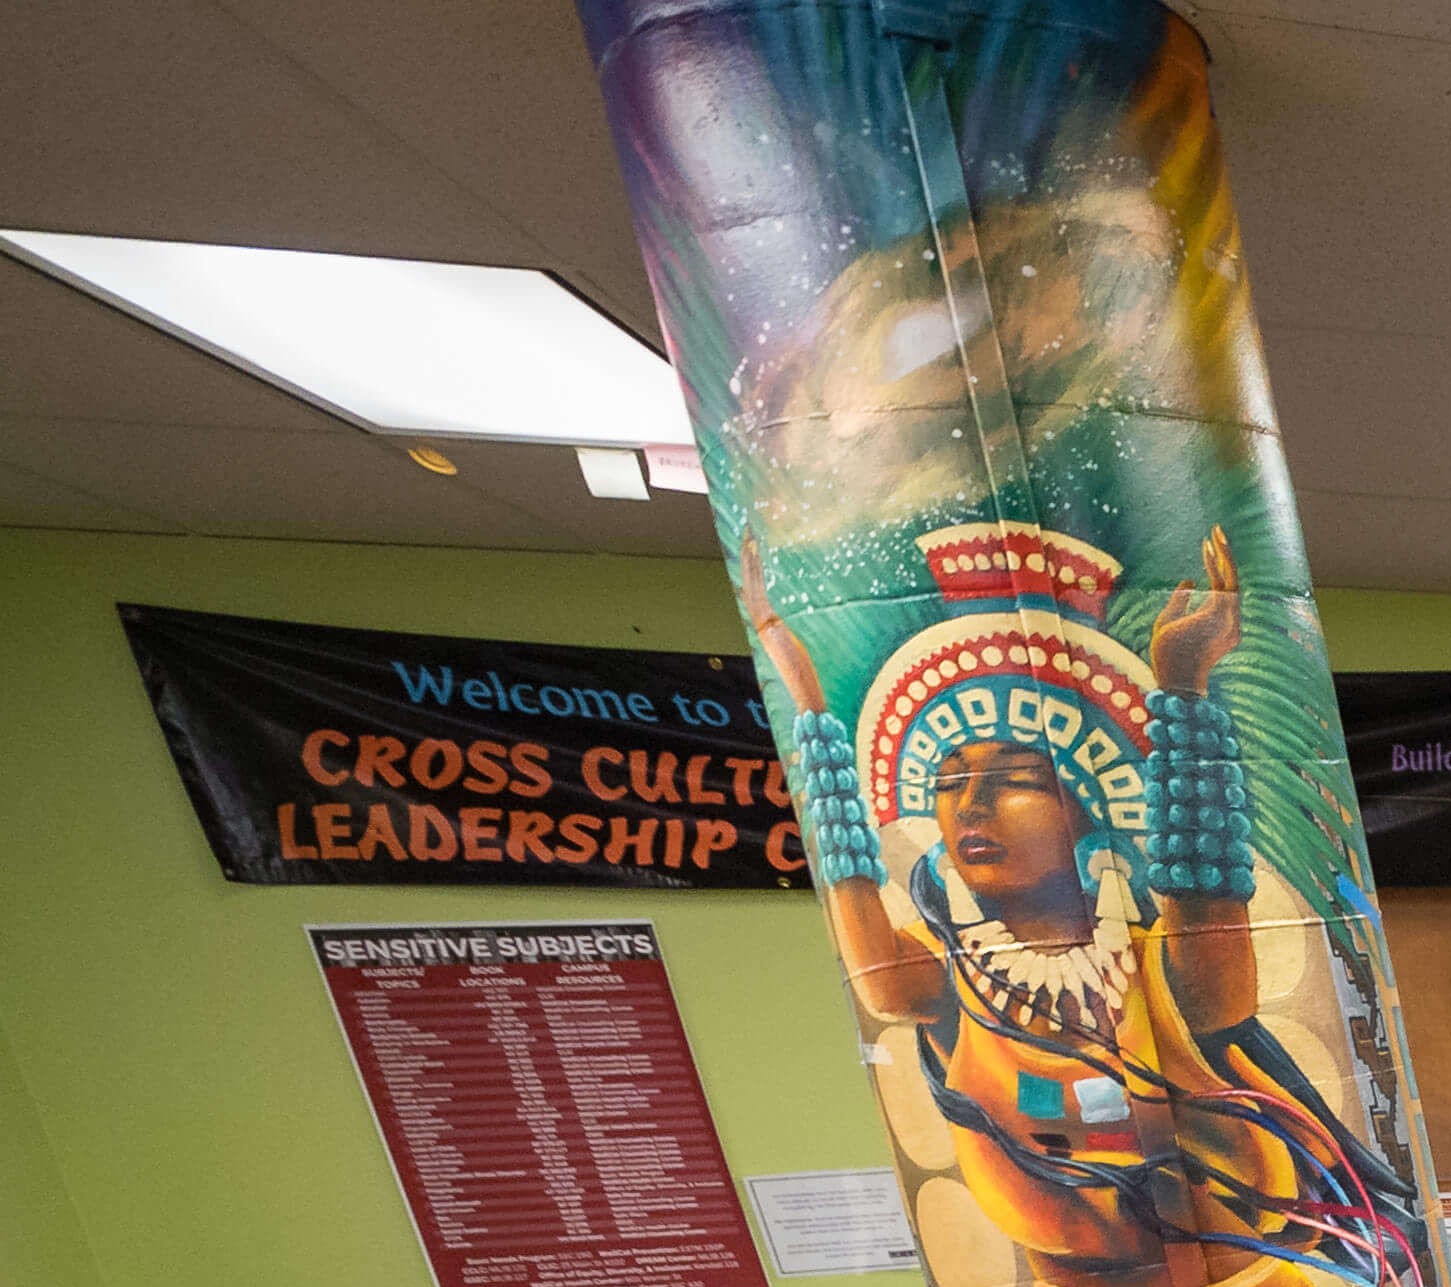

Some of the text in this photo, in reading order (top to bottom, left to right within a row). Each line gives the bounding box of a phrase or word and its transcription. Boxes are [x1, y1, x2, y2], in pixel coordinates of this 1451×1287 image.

[392, 661, 659, 723] Welcome
[672, 694, 730, 727] to
[301, 728, 553, 798] CROSS
[278, 803, 738, 869] LEADERSHIP
[325, 933, 654, 961] SENSITIVE SUBJECTS
